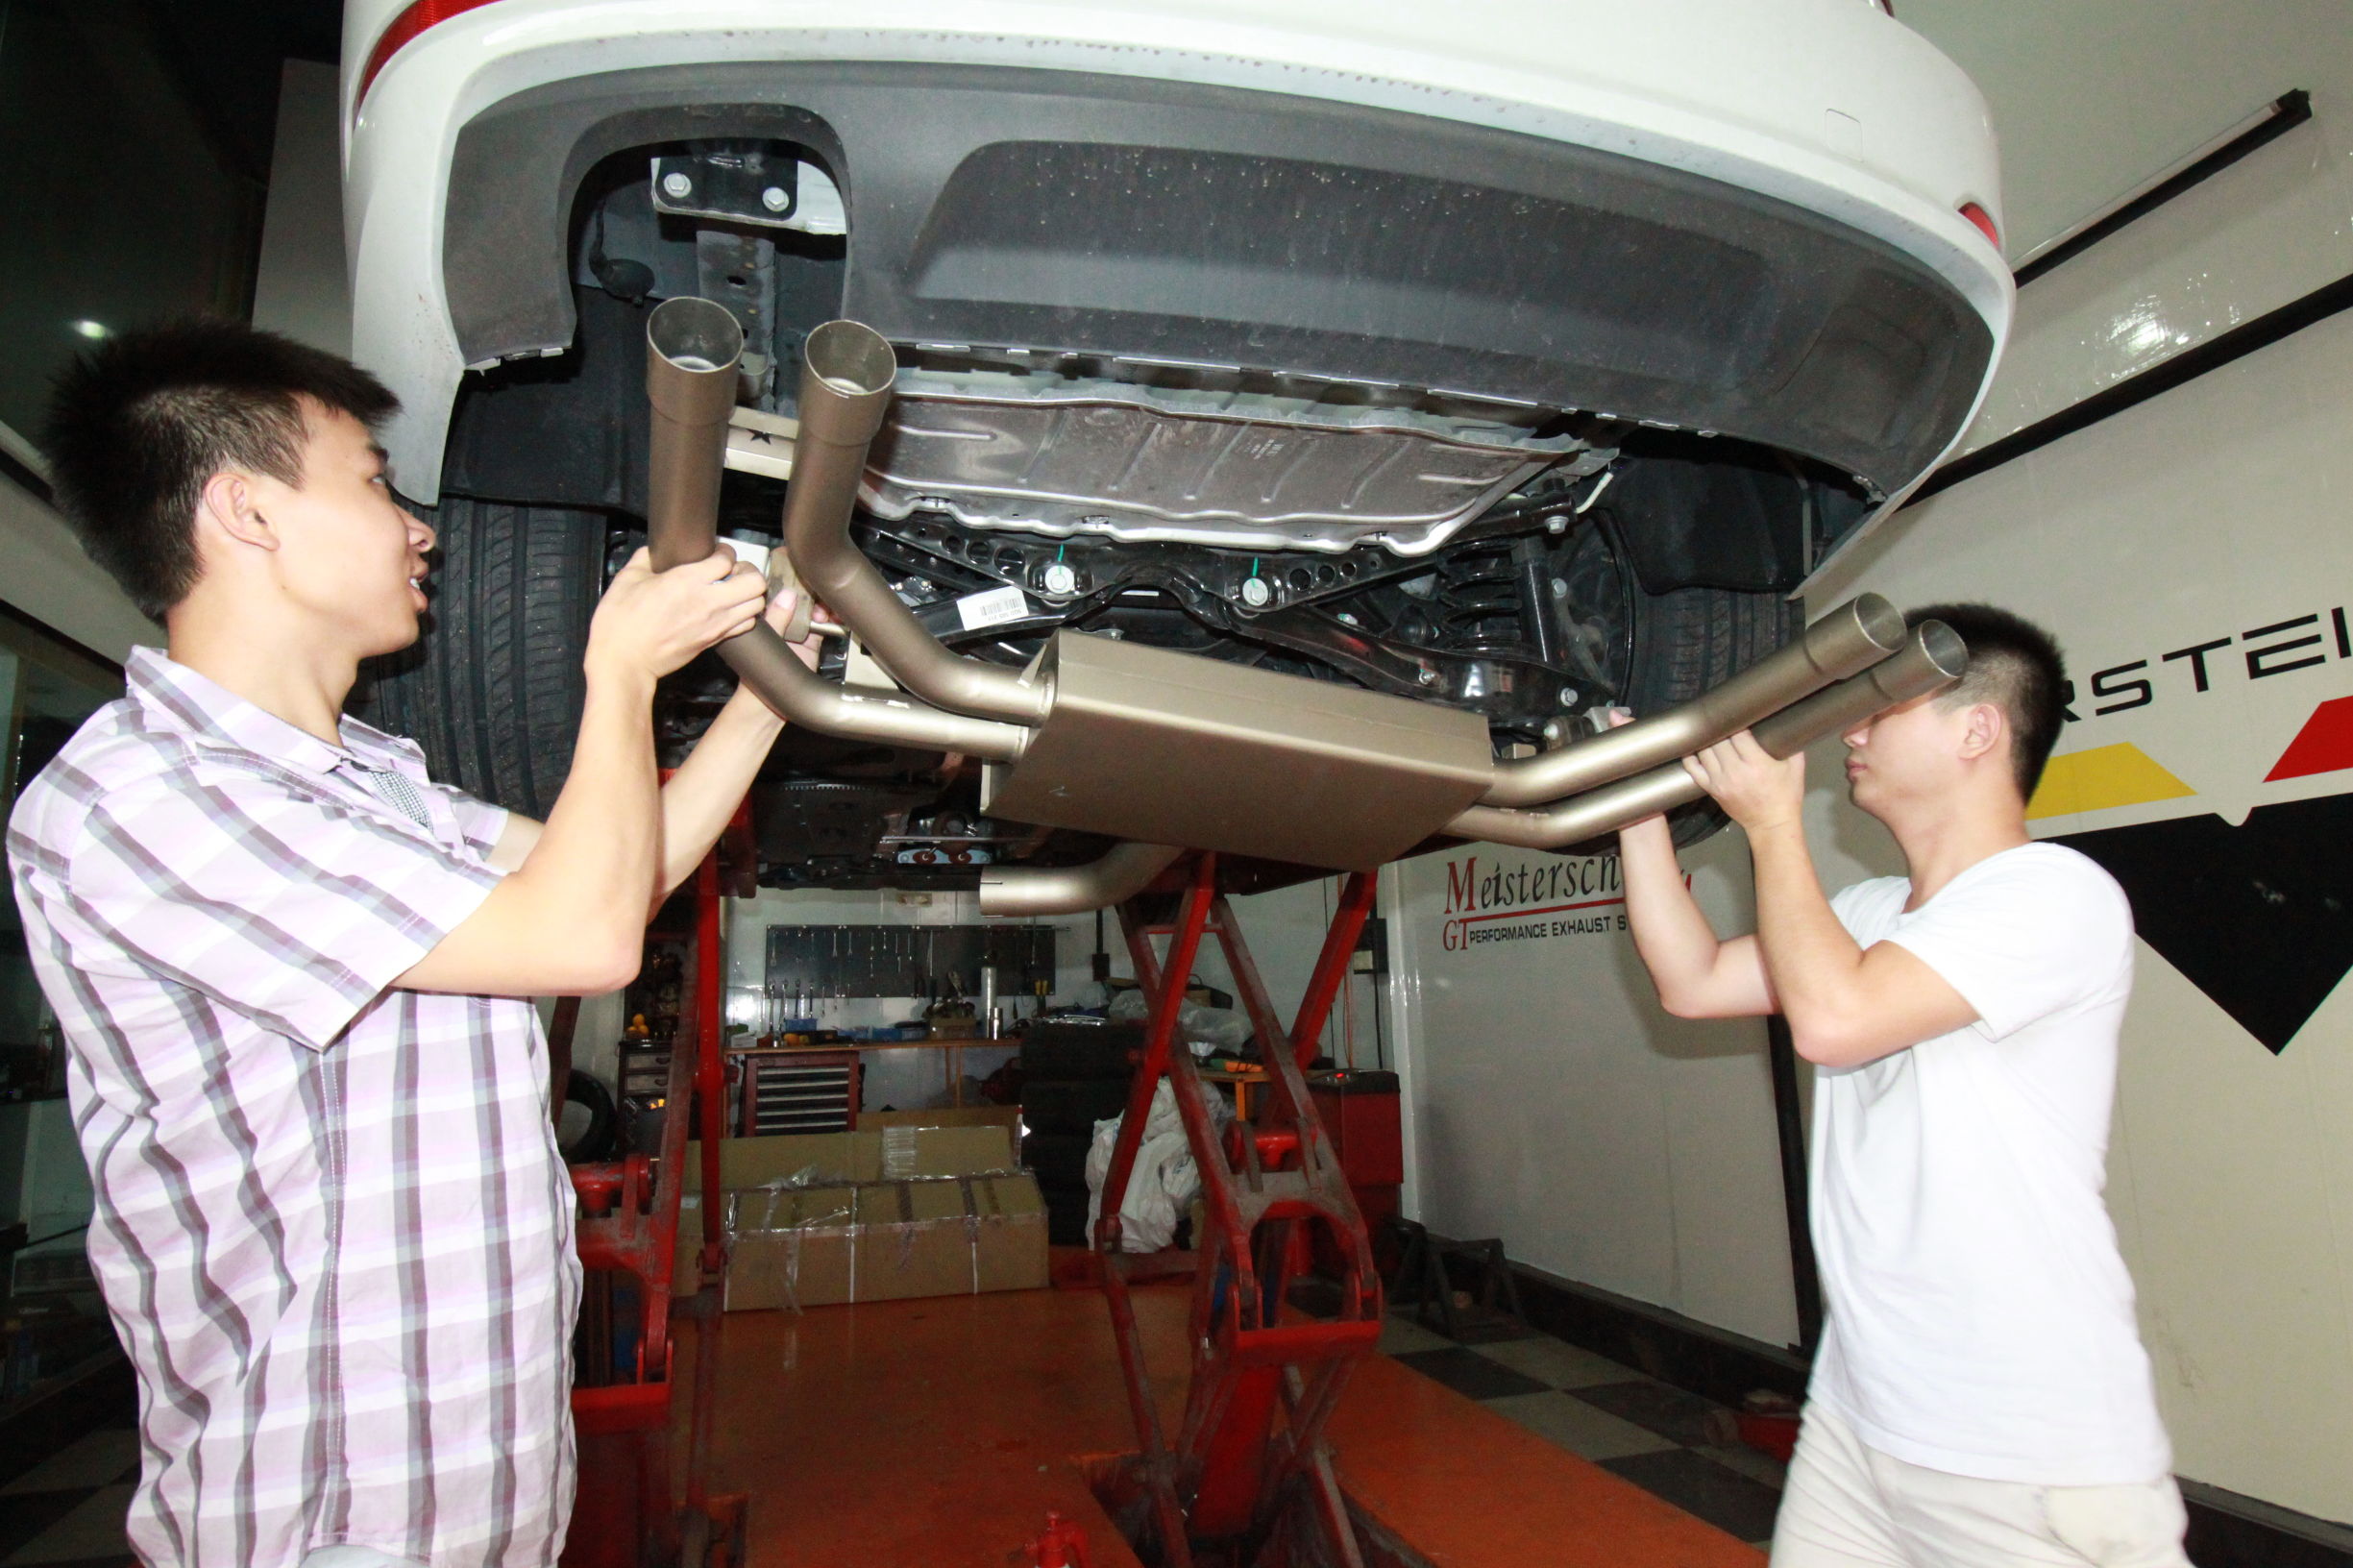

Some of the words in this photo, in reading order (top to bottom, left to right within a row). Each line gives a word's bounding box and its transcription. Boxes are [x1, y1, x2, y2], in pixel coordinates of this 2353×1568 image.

[1444, 854, 1620, 914] Meistersch
[1469, 922, 1547, 943] PERFORMANCE
[1552, 916, 1611, 938] EXHAUST
